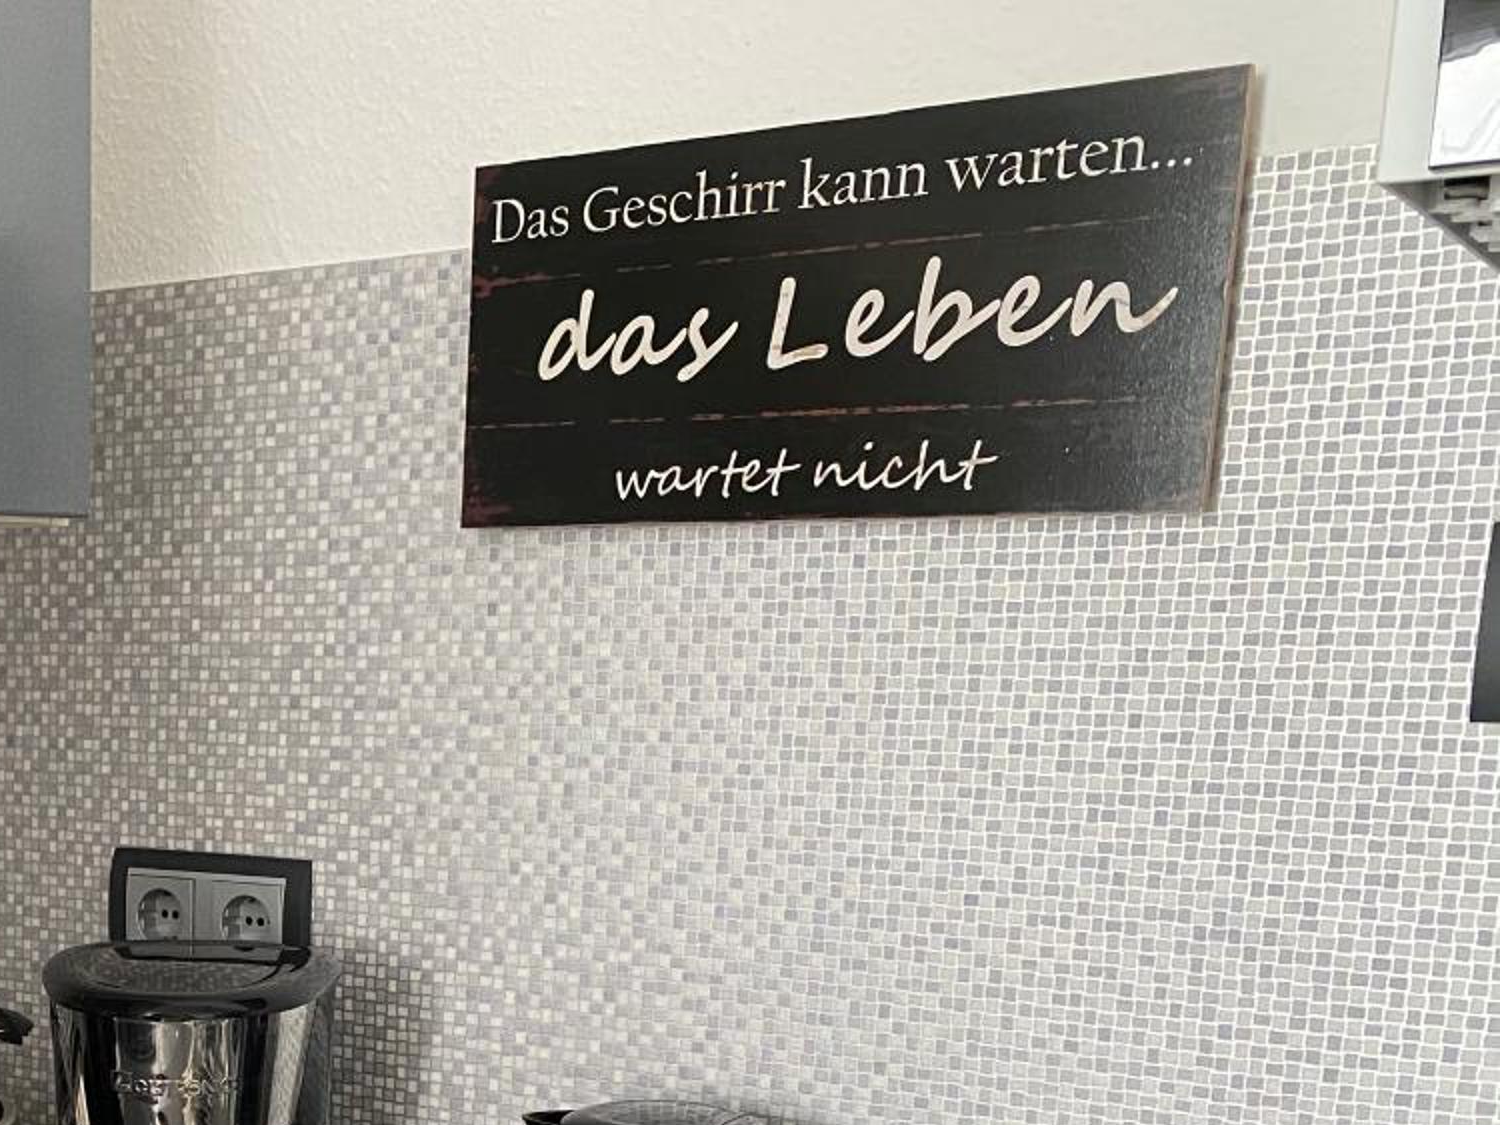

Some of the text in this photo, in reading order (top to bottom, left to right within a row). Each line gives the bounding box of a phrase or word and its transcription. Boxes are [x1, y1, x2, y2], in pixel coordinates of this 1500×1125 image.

[491, 135, 1193, 244] Das Geschirr kann warten...
[538, 256, 1179, 382] das Leben
[615, 439, 999, 500] wartet nicht
